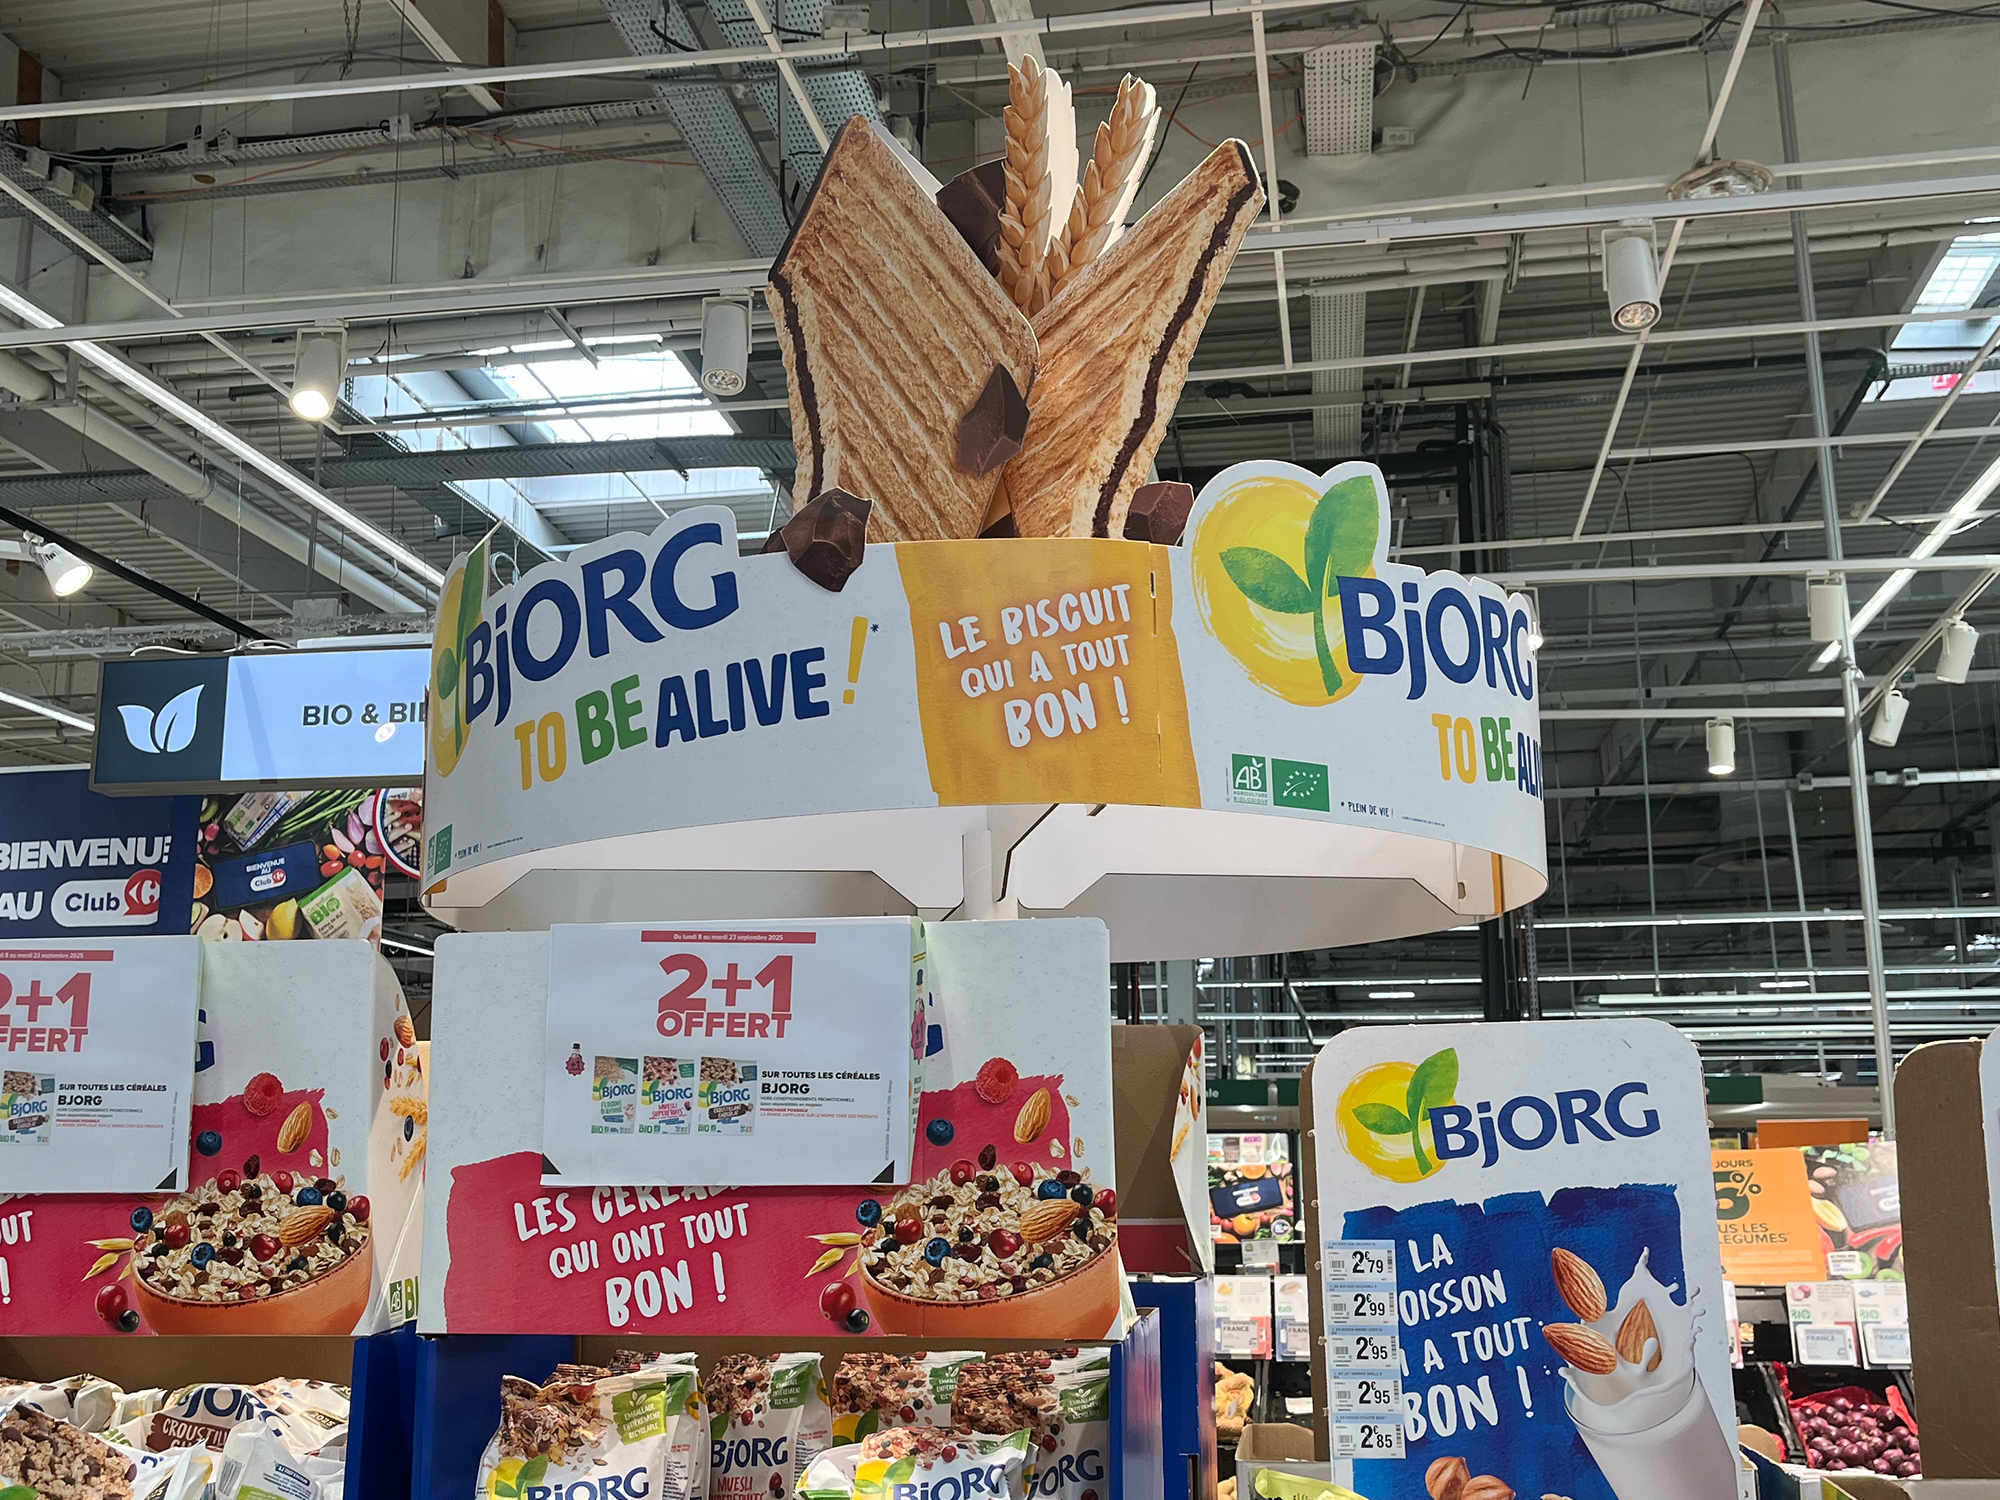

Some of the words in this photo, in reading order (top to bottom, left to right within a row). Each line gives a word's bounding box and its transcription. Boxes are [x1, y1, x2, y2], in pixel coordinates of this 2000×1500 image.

[465, 522, 740, 727] BjORG
[939, 616, 987, 659] LE
[1001, 584, 1131, 645] BISCUIT
[1336, 576, 1535, 701] BjORG
[960, 659, 1014, 698] QUI
[1029, 650, 1053, 682] A
[1061, 634, 1129, 675] TOUT
[302, 704, 352, 726] BIO
[361, 703, 379, 724] &
[514, 711, 567, 790] TO
[575, 674, 648, 765] BE
[655, 647, 831, 748] ALIVE
[1003, 682, 1097, 748] BON
[1431, 713, 1477, 784] TO
[1480, 717, 1516, 782] BE
[1235, 766, 1262, 790] AB
[1233, 790, 1268, 798] AGRICULTURE
[1347, 801, 1367, 814] PLEIN
[1369, 804, 1378, 815] DE
[1379, 806, 1390, 817] VIE
[246, 857, 286, 873] BIENVENUE
[255, 878, 272, 887] Club
[0, 890, 44, 920] AU
[65, 892, 121, 912] Club
[658, 953, 793, 1014] 2+1
[0, 972, 91, 1027] +1
[656, 1011, 792, 1038] OFFERT
[59, 1083, 76, 1091] SUR
[111, 1084, 124, 1092] LES
[126, 1082, 167, 1092] CÉRÉALES
[761, 1083, 810, 1095] BJORG
[762, 1071, 780, 1079] SUR
[782, 1071, 816, 1079] TOUTES
[818, 1071, 834, 1080] LES
[835, 1071, 880, 1081] CÉRÉALES
[58, 1095, 103, 1106] BJORG
[602, 1084, 636, 1099] BjORG
[653, 1087, 693, 1103] BjORG
[710, 1088, 751, 1106] BjORG
[11, 1100, 48, 1117] BjORG
[639, 1124, 653, 1133] BIO
[1428, 1082, 1661, 1168] BjORG
[1715, 1159, 1753, 1168] JOURS
[514, 1192, 577, 1241] LES
[1742, 1222, 1769, 1233] LES
[549, 1239, 600, 1278] QUI
[612, 1222, 666, 1264] ONT
[680, 1202, 749, 1249] TOUT
[1408, 1233, 1454, 1273] LA
[404, 1275, 419, 1320] BI
[605, 1259, 694, 1327] BON
[1398, 1269, 1507, 1326] OISSON
[1424, 1338, 1445, 1374] A
[1451, 1317, 1532, 1364] TOUT
[624, 1402, 655, 1421] EMBALLAGE
[1403, 1375, 1498, 1442] BON
[628, 1422, 660, 1439] RECYCLABLE
[711, 1436, 789, 1474] BjORG
[717, 1475, 753, 1492] MUESLI
[1027, 1449, 1105, 1500] jORG
